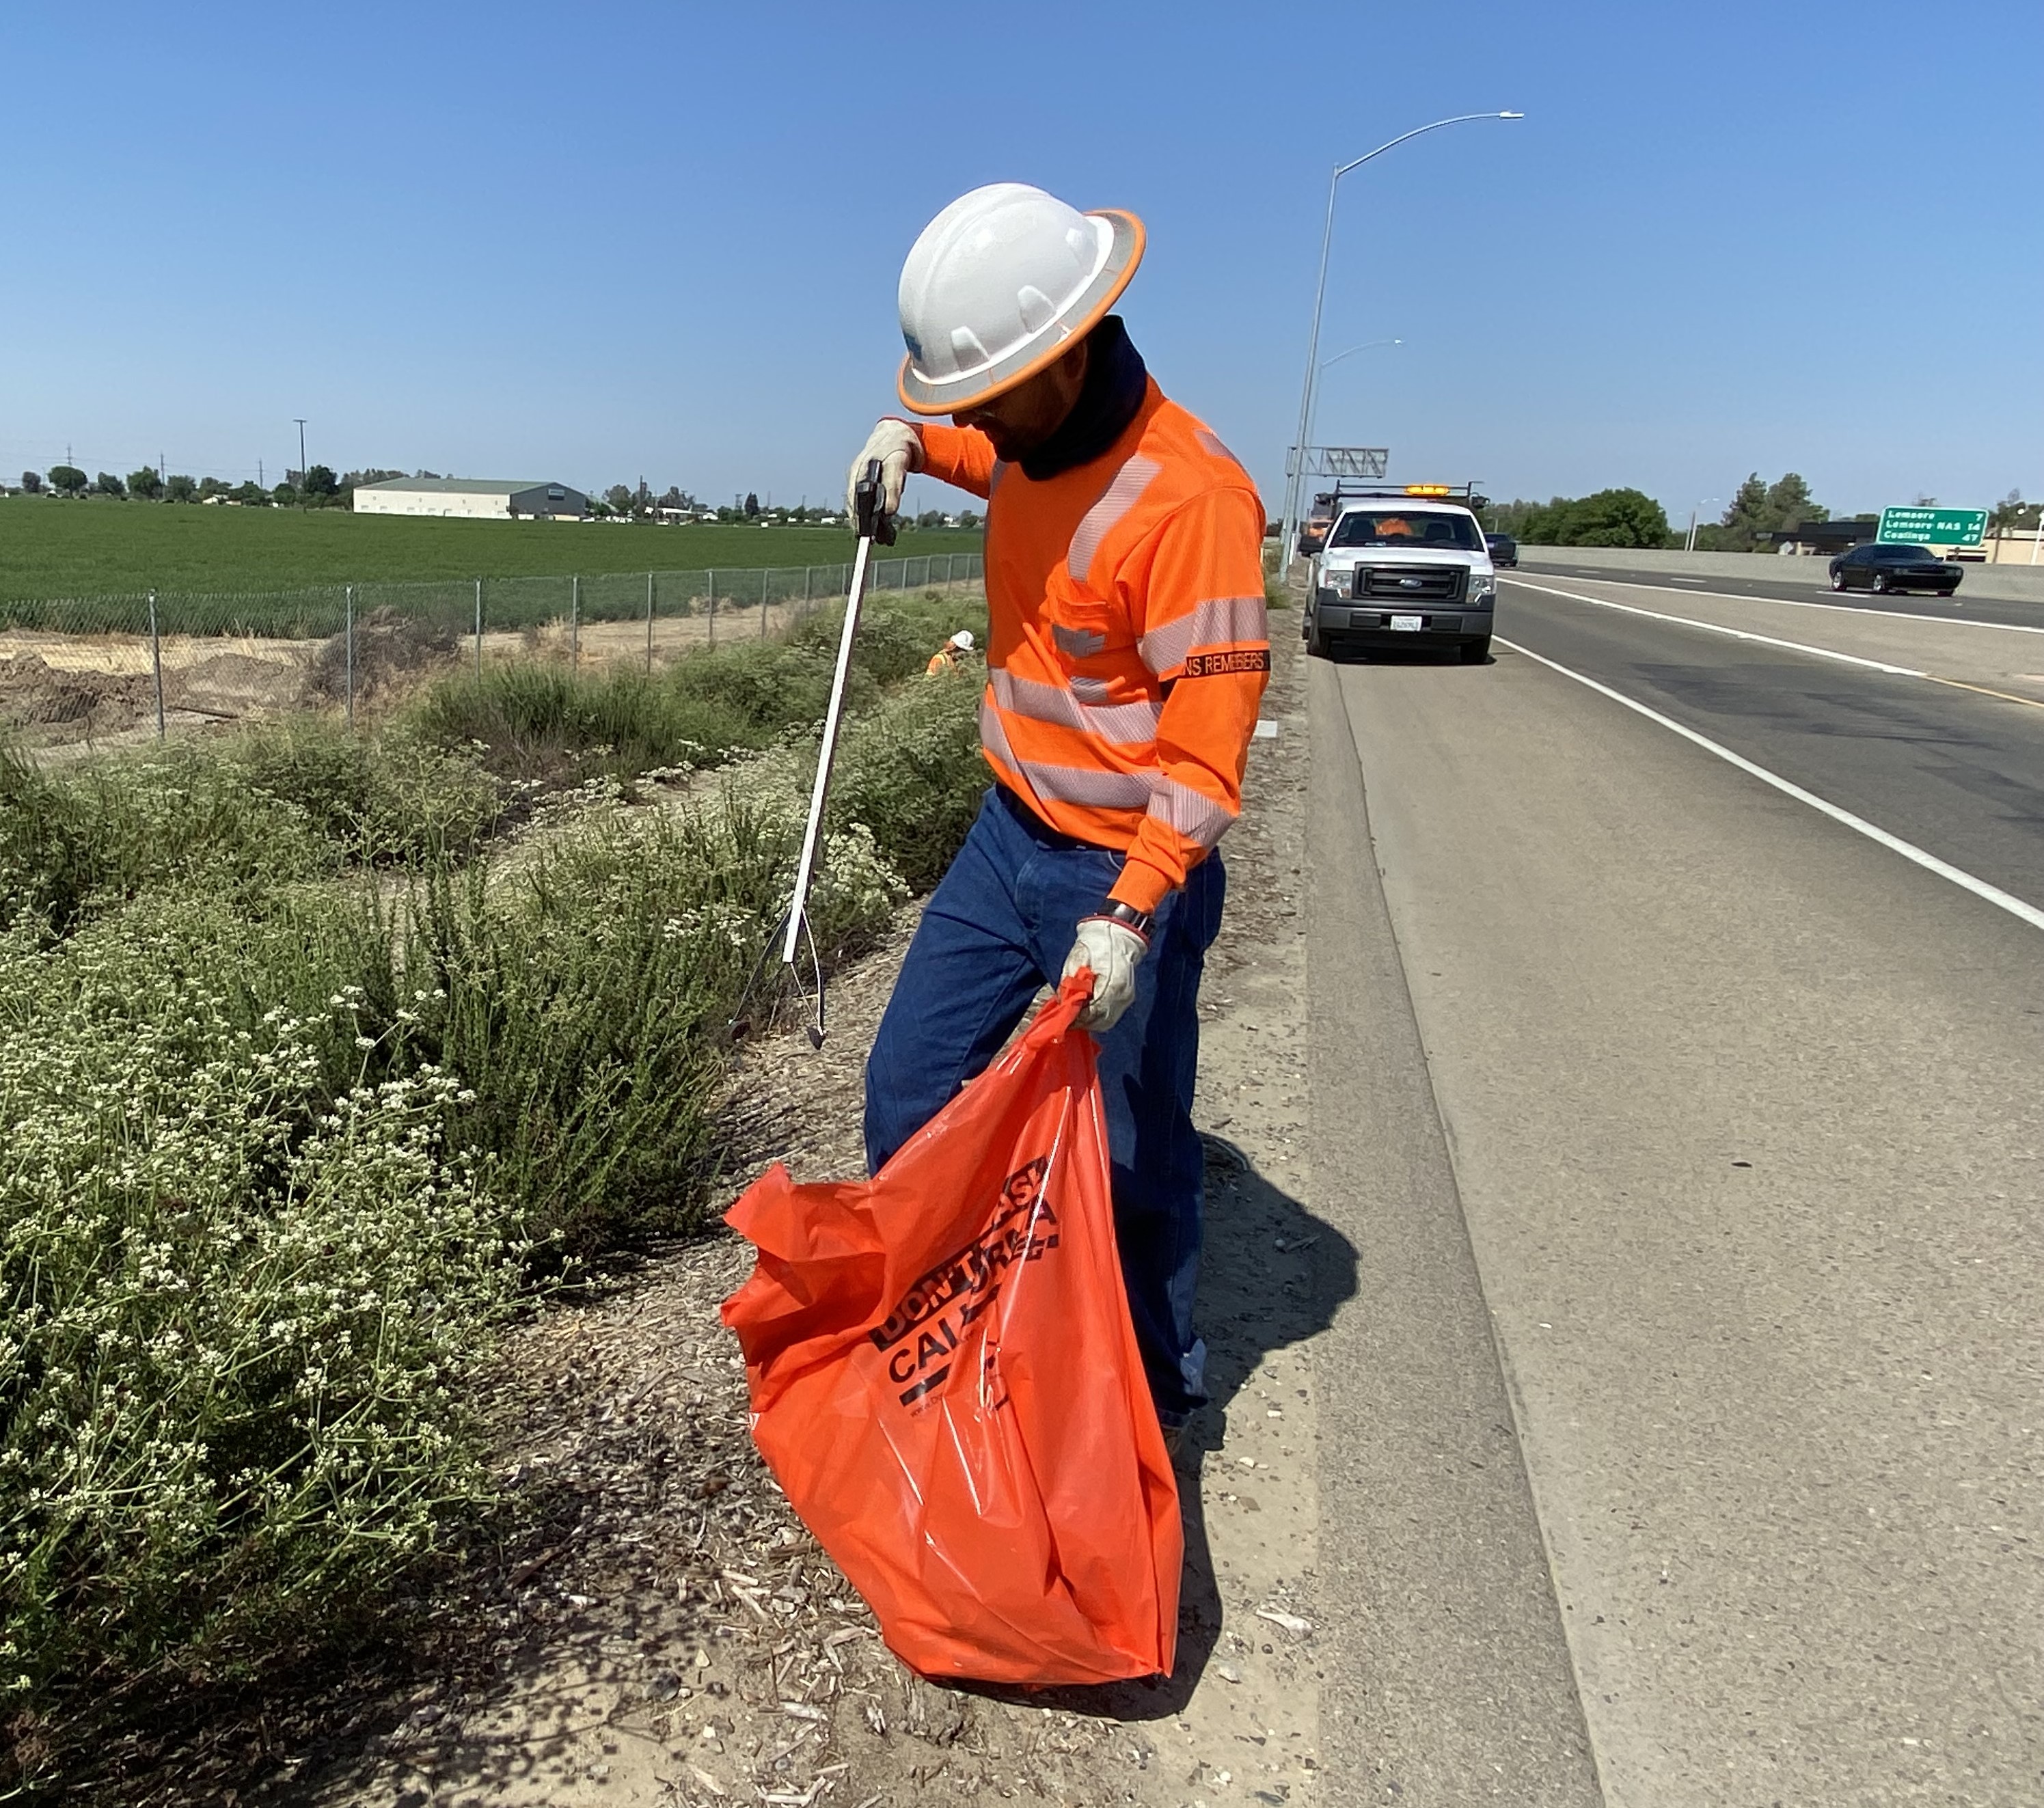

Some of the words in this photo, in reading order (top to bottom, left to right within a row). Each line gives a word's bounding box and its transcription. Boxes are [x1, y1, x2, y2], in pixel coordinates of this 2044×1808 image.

[1888, 510, 1935, 519] Lemoore
[1976, 513, 1983, 521] 7
[1937, 522, 1961, 530] NAS
